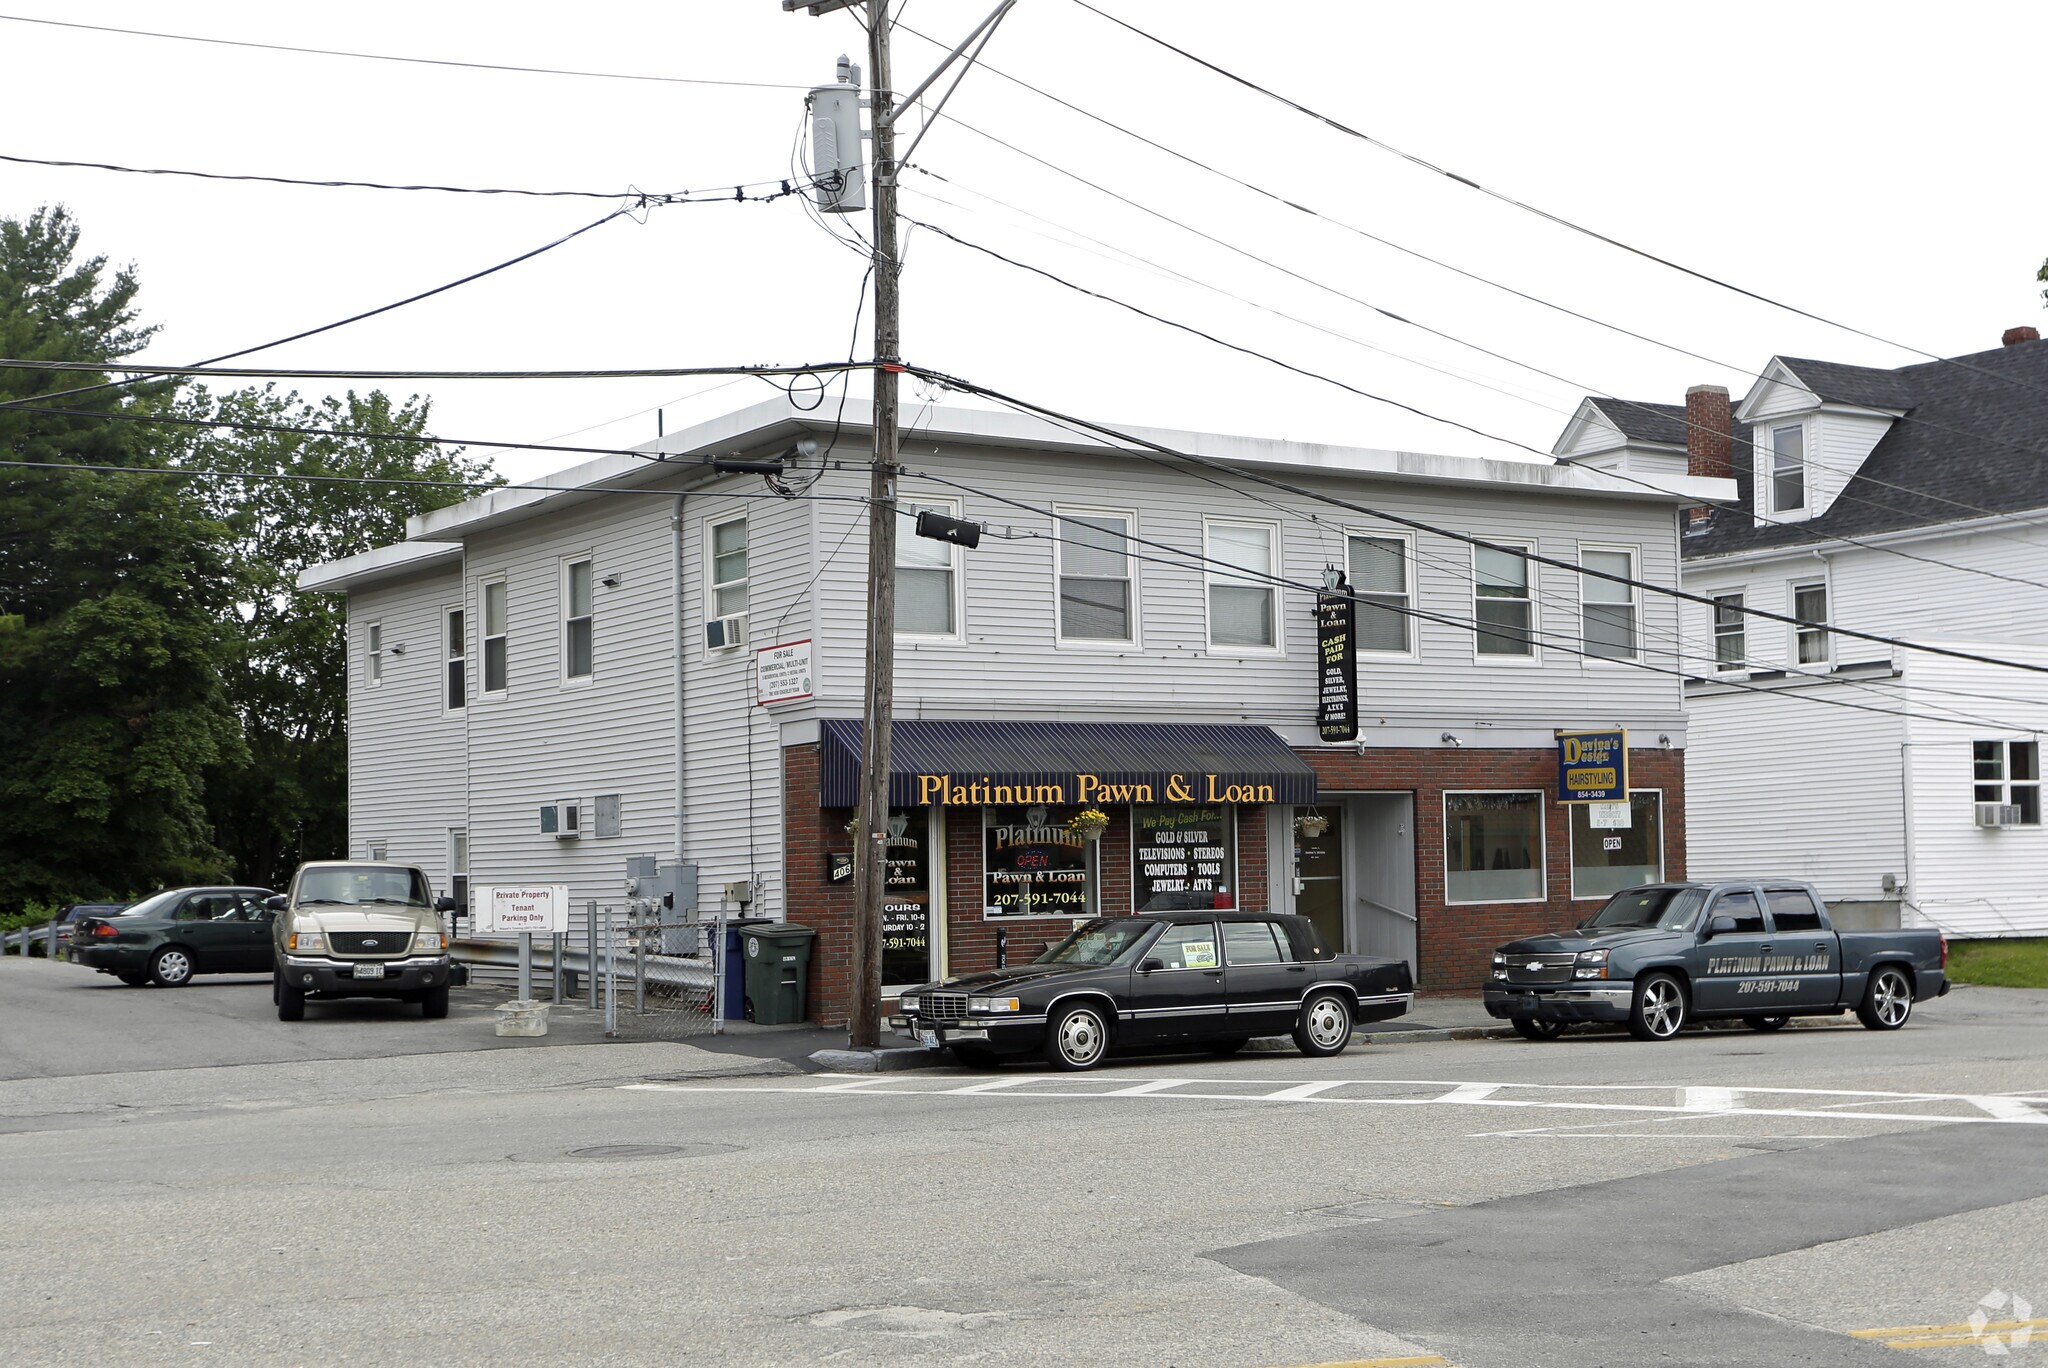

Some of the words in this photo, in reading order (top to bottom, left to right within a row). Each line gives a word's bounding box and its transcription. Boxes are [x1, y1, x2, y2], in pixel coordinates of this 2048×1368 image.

[1320, 603, 1346, 612] Pawn
[1321, 619, 1346, 627] Loan
[1322, 634, 1346, 648] CASH
[774, 651, 782, 659] FOR
[783, 649, 793, 658] SALE
[1325, 644, 1344, 656] PAID
[1326, 653, 1343, 664] FOR
[1325, 676, 1344, 684] SILVER,
[1569, 772, 1613, 785] HAIRSTYLING
[918, 775, 1064, 804] Platinum
[1076, 774, 1154, 802] Pawn
[1166, 774, 1195, 802] &
[1206, 775, 1274, 802] Loan
[1143, 818, 1156, 828] We
[1160, 816, 1175, 828] Pay
[1178, 811, 1197, 824] Cash
[1202, 810, 1222, 821] For...
[886, 836, 917, 848] atinum
[996, 824, 1084, 849] Platinum
[1156, 832, 1175, 843] GOLD
[1177, 831, 1182, 843] &
[1184, 831, 1208, 843] SILVER
[1605, 839, 1620, 848] OPEN
[1139, 848, 1185, 860] TELEVISIONS
[1194, 847, 1224, 859] STEREOS
[1017, 856, 1048, 866] OPEN
[835, 865, 850, 878] 406
[894, 868, 902, 876] &
[1145, 864, 1187, 876] COMPUTERS
[1198, 863, 1220, 875] TOOLS
[993, 872, 1032, 883] Pawn
[1036, 871, 1044, 882] &
[1049, 872, 1087, 882] Loan
[1152, 880, 1184, 892] JEWELRY
[994, 891, 1086, 905] 207-591-7044
[530, 914, 543, 922] Only
[882, 936, 925, 948] 7-591-7044
[1707, 957, 1760, 974] PLATINUM
[1763, 956, 1794, 972] PAWN
[1794, 958, 1802, 971] &
[1804, 955, 1829, 971] LOAN
[1738, 980, 1799, 993] 207-591-7044
